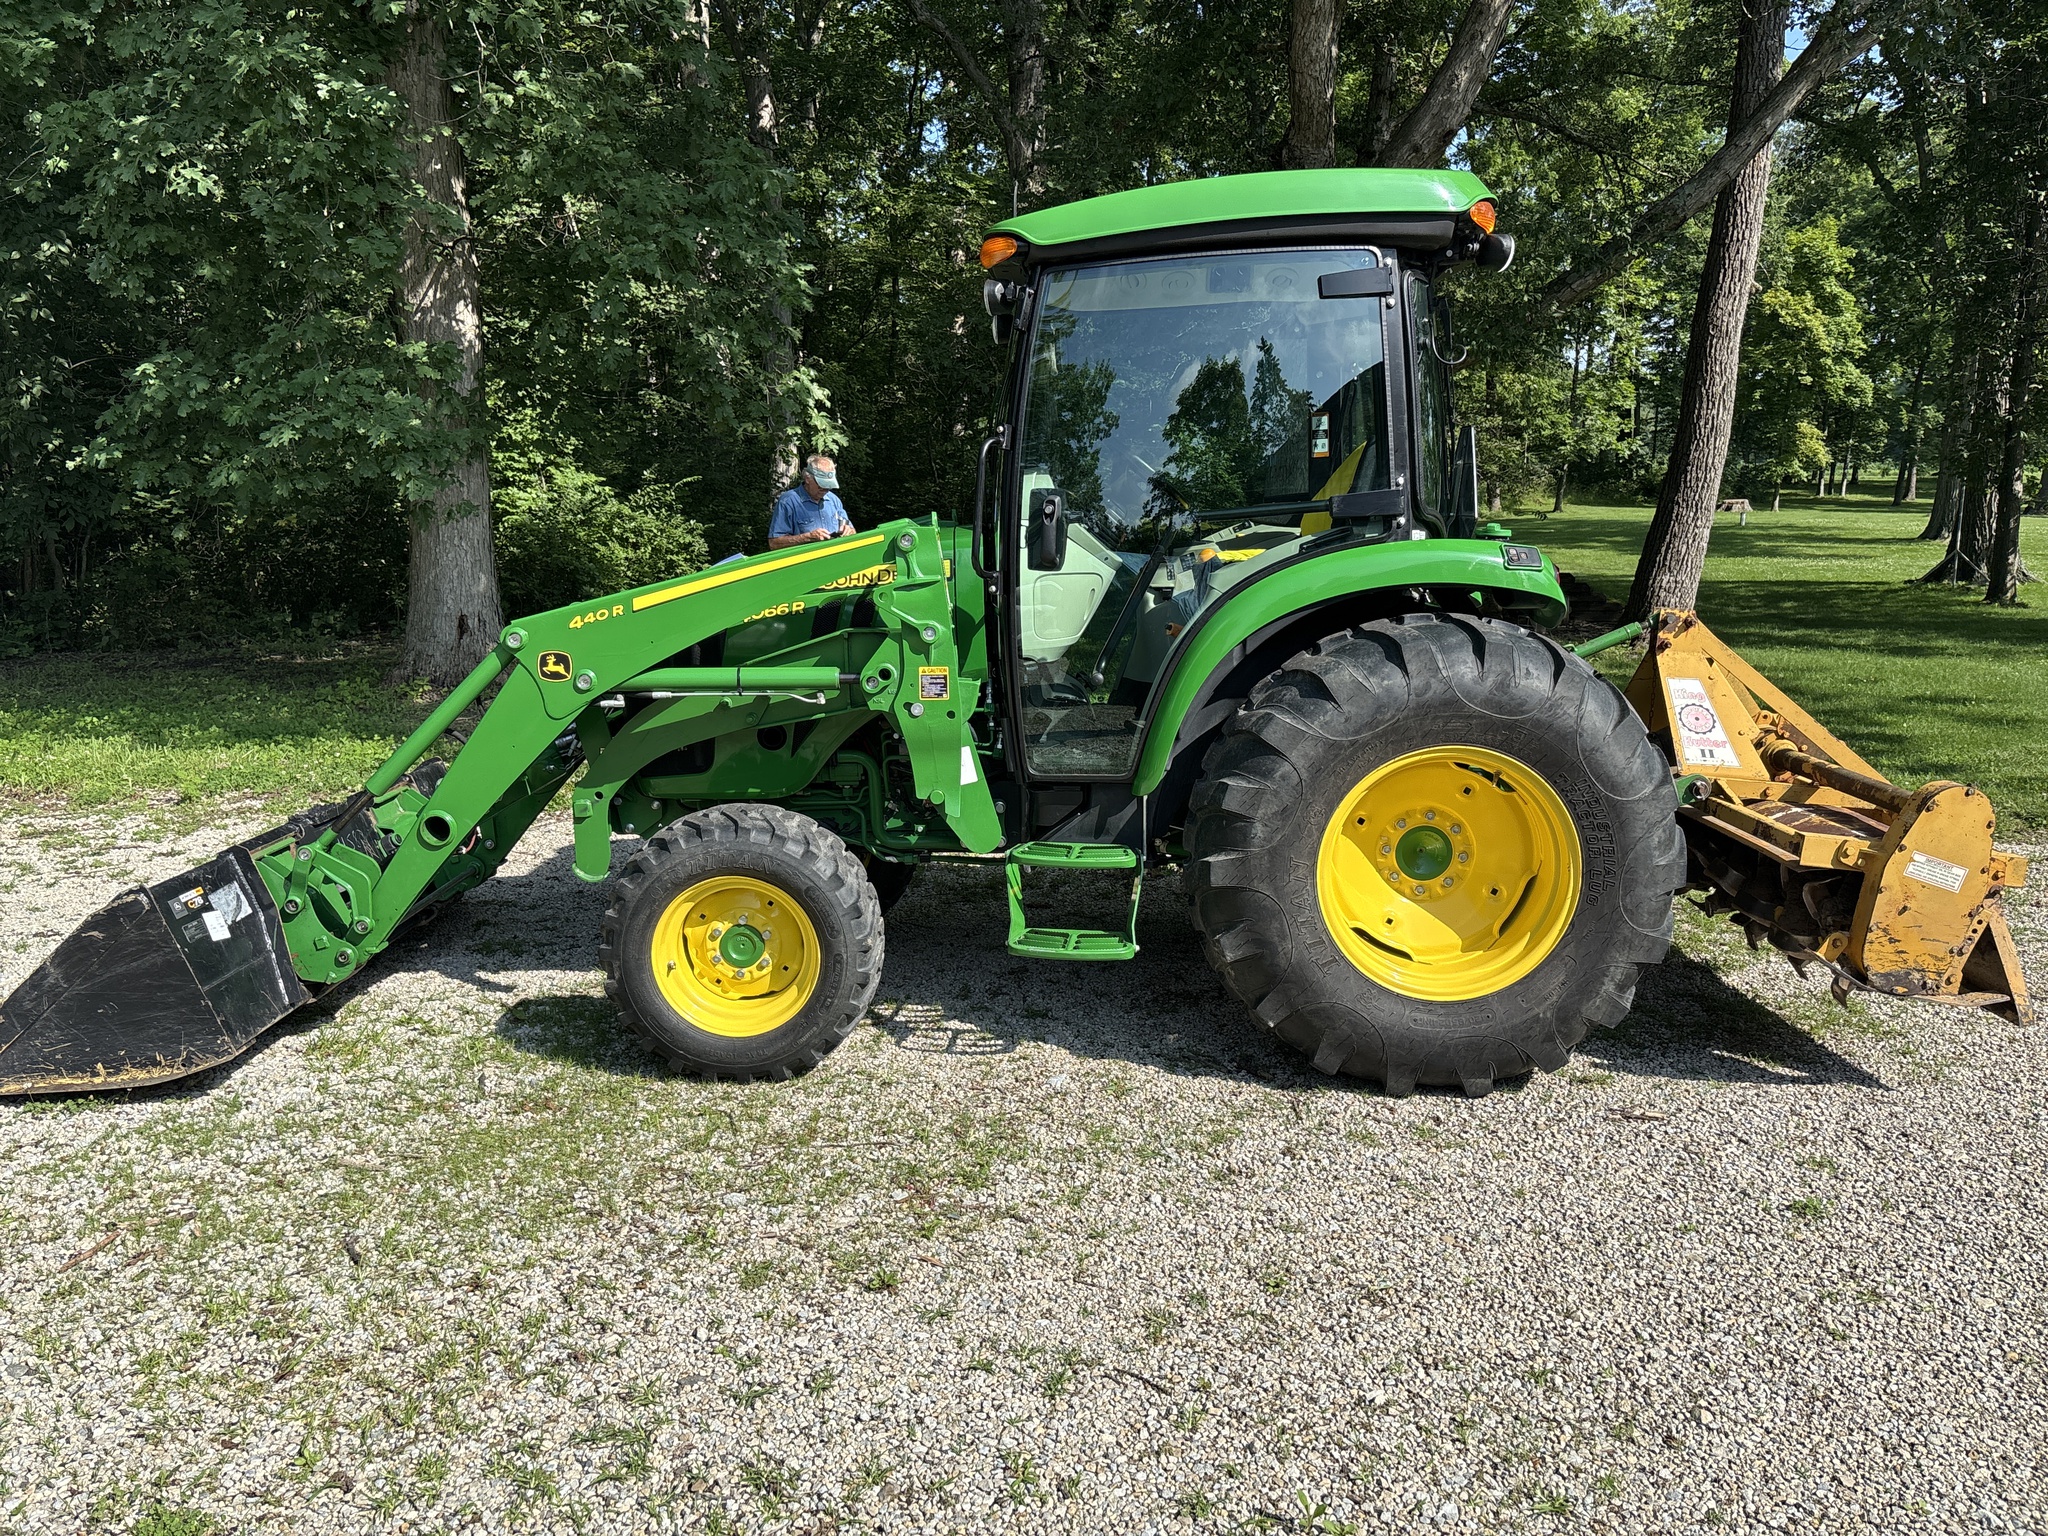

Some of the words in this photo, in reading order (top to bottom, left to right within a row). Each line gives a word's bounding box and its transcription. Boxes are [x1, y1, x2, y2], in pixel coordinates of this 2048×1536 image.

[568, 609, 609, 629] 440
[612, 604, 625, 618] R
[743, 603, 789, 623] 66
[791, 601, 805, 615] R
[1673, 688, 1706, 703] King
[1683, 736, 1728, 749] Kutter
[1554, 771, 1601, 859] TRACTOR
[1585, 868, 1603, 907] LUG
[1574, 778, 1617, 892] INDUSTRIAL
[686, 852, 778, 876] TITAN
[1925, 857, 1954, 871] IMPORTANT
[187, 896, 204, 909] C78
[1289, 855, 1342, 978] TITAN
